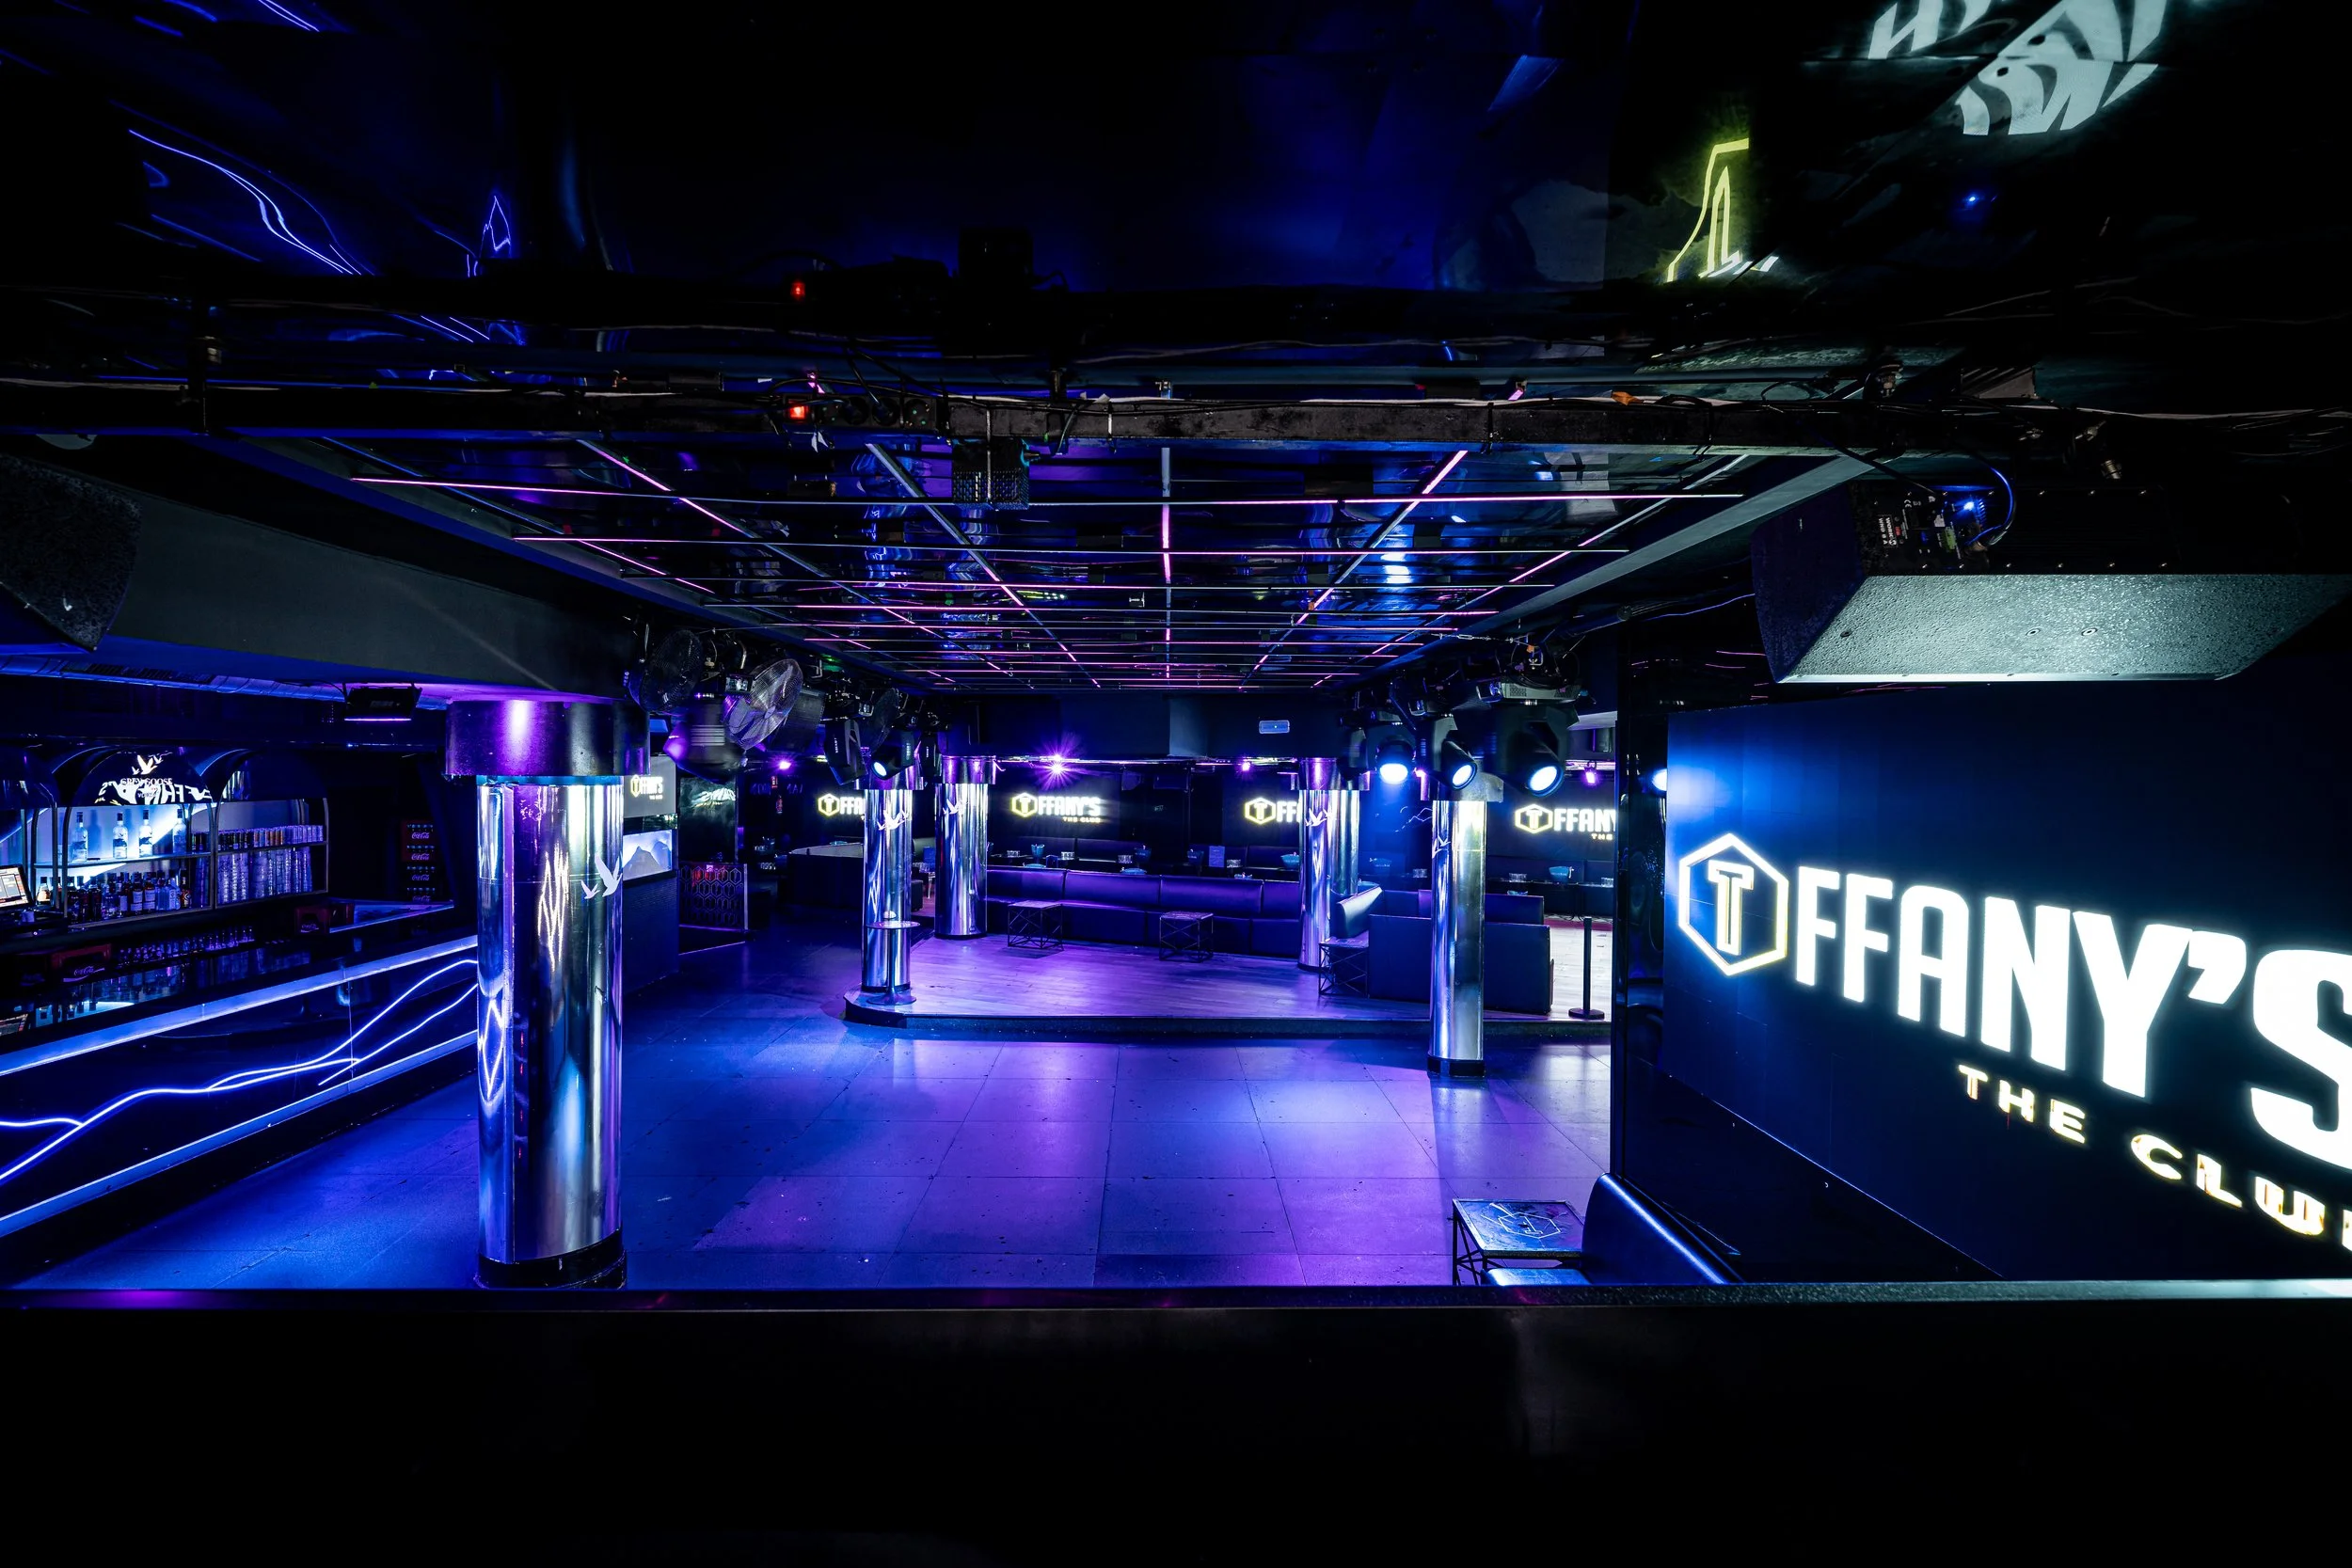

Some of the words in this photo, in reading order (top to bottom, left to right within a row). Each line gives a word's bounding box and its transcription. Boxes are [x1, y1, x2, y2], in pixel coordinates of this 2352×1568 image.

[1591, 832, 1613, 841] THE
[1957, 1064, 2087, 1145] THE
[2130, 1133, 2352, 1253] CLU
